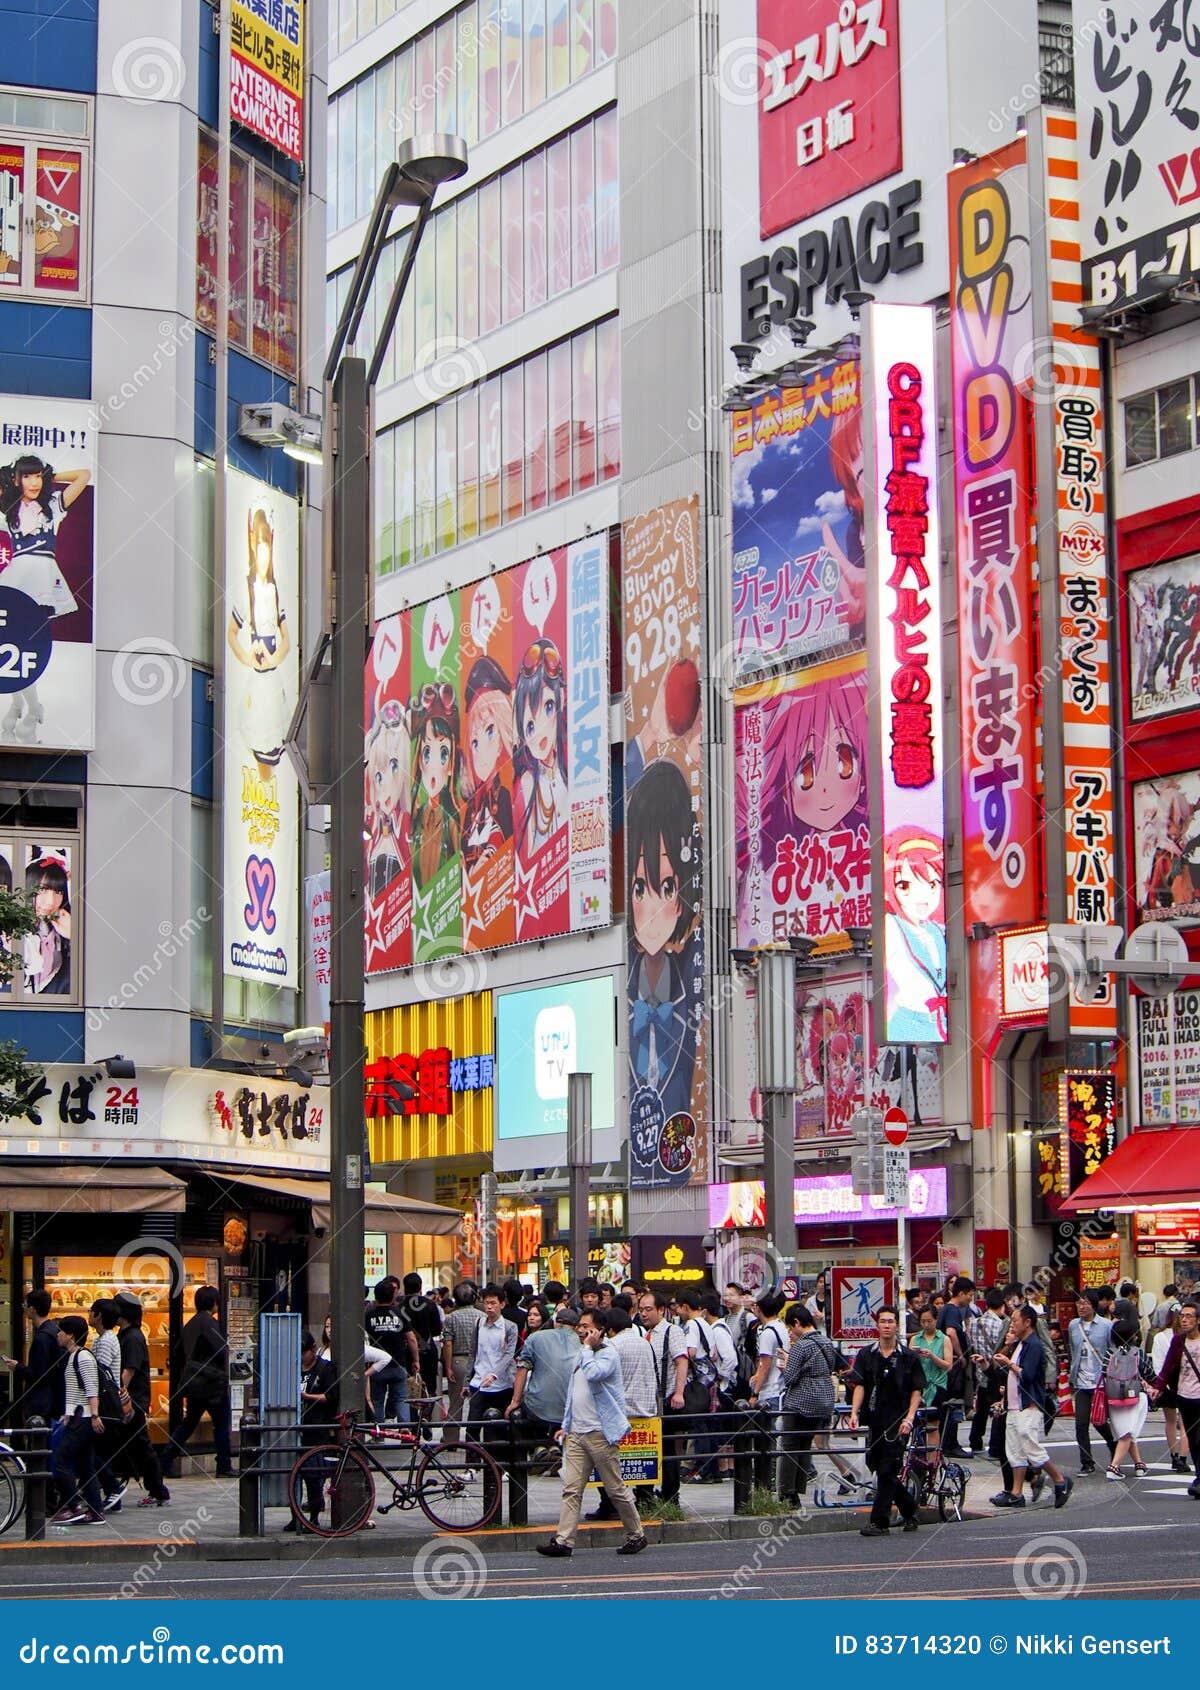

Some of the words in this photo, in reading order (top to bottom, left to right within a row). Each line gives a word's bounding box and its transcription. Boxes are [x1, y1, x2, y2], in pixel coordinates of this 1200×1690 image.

[764, 0, 888, 112] エスパス
[796, 100, 854, 167] 日拓
[741, 179, 924, 343] ESPACE
[732, 362, 859, 457] 日本最大級
[625, 549, 680, 605] Blu-ray
[625, 604, 682, 684] 9.28
[231, 942, 287, 976] maidreamin
[449, 1053, 494, 1093] 秋葉原
[546, 1058, 565, 1081] TV
[104, 1086, 140, 1108] 24
[104, 1108, 139, 1126] 時間
[308, 1107, 324, 1127] 24
